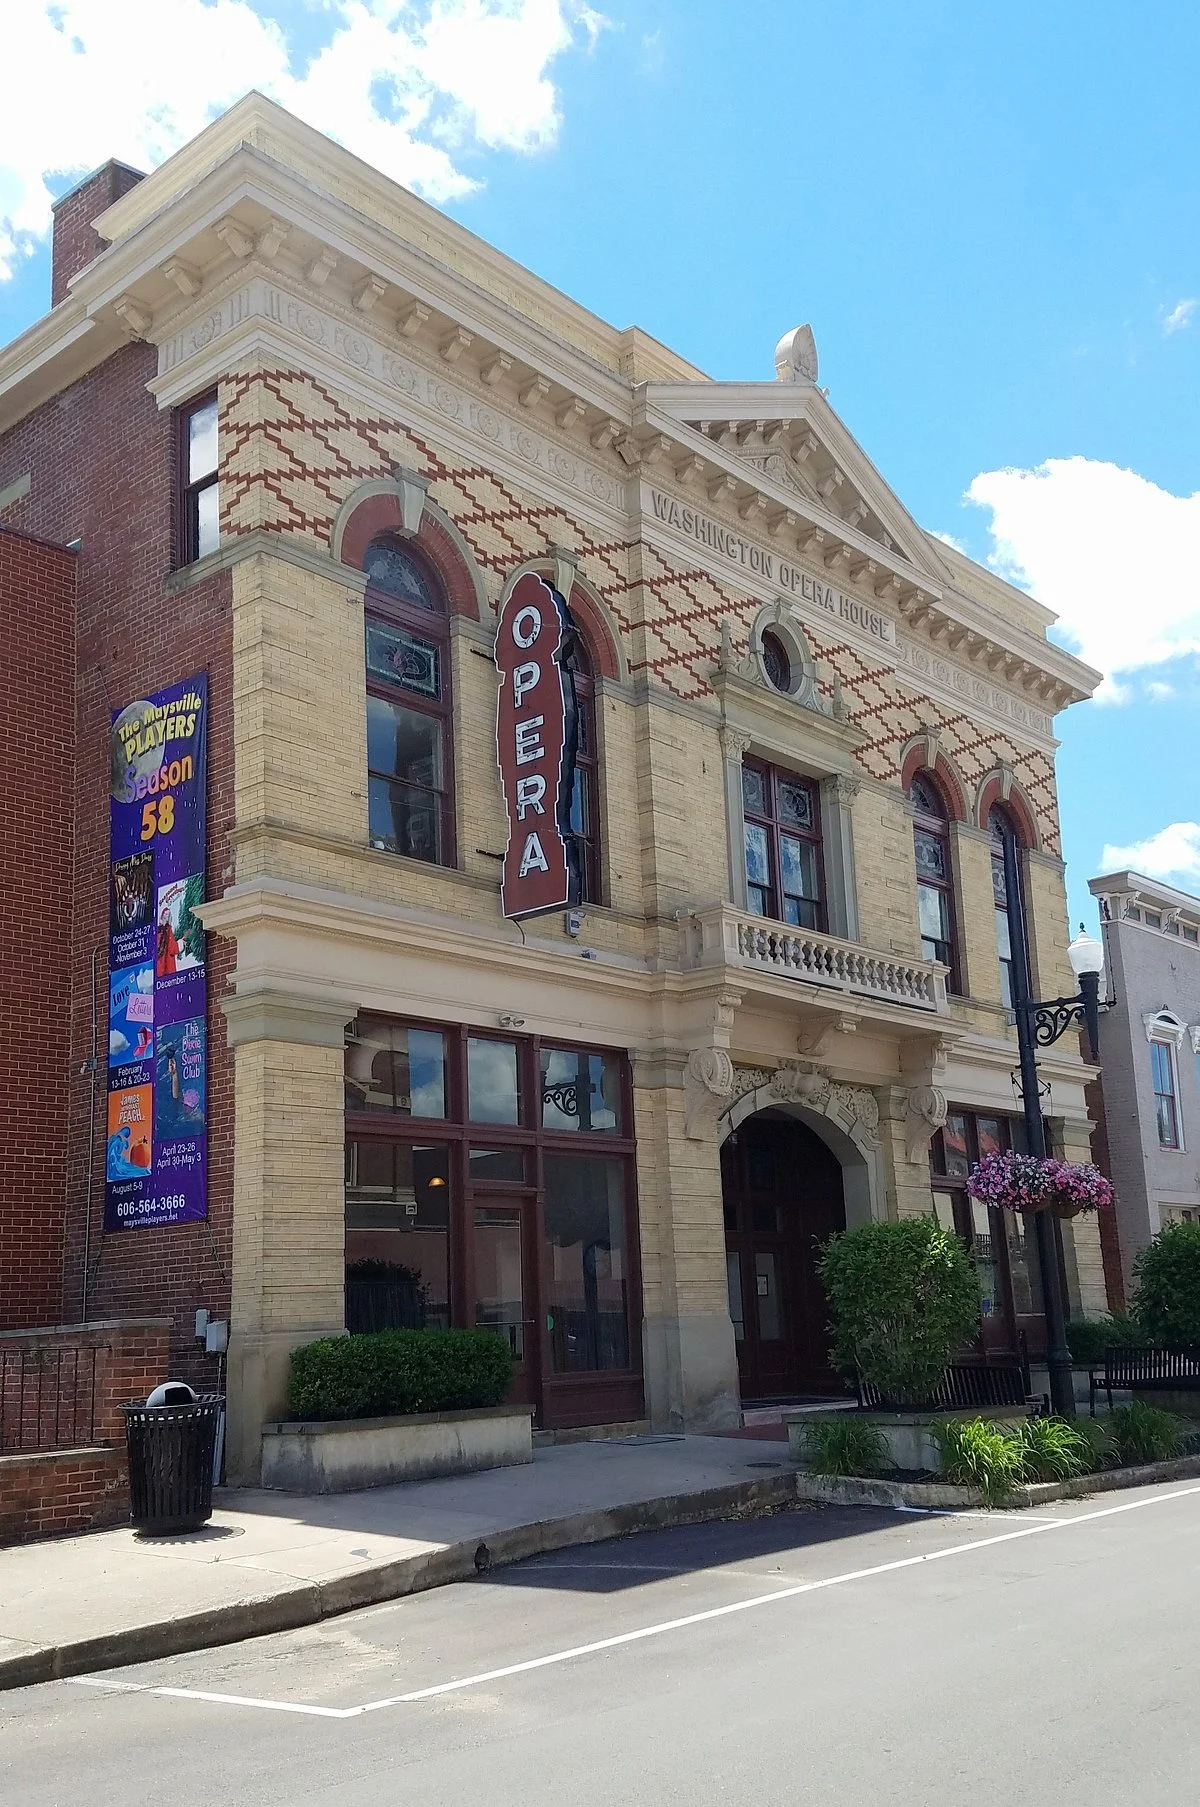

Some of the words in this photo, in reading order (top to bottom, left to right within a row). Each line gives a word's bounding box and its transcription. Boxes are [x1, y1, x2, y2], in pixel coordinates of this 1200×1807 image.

[650, 489, 774, 580] WASHINGTON
[779, 562, 836, 613] OPERA
[838, 594, 891, 642] HOUSE
[118, 719, 141, 743] The
[143, 692, 202, 726] Maysville
[124, 713, 197, 765] PLAYERS
[511, 605, 549, 879] OPERA
[124, 755, 193, 804] Season
[140, 795, 175, 841] 58
[112, 931, 134, 945] October
[134, 924, 151, 938] 24-27
[117, 940, 138, 953] October
[137, 936, 145, 948] 31
[142, 946, 148, 956] 3
[156, 975, 187, 991] December
[187, 968, 206, 982] 13-15
[112, 985, 130, 1008] Love
[184, 1022, 200, 1038] The
[181, 1052, 202, 1066] Swim
[117, 1066, 143, 1078] February
[182, 1063, 201, 1080] Club
[111, 1077, 128, 1089] 13-16
[127, 1075, 133, 1086] &
[133, 1072, 151, 1084] 20-23
[117, 1109, 142, 1126] PEACH
[161, 1143, 177, 1158] April
[177, 1141, 196, 1154] 23-26
[156, 1156, 171, 1170] April
[171, 1153, 196, 1166] 30-May
[196, 1152, 202, 1162] 3
[112, 1183, 133, 1196] August
[133, 1180, 143, 1191] 5-9
[117, 1193, 186, 1217] 606-564-3666
[123, 1212, 179, 1229] maysvilleplayers.net
